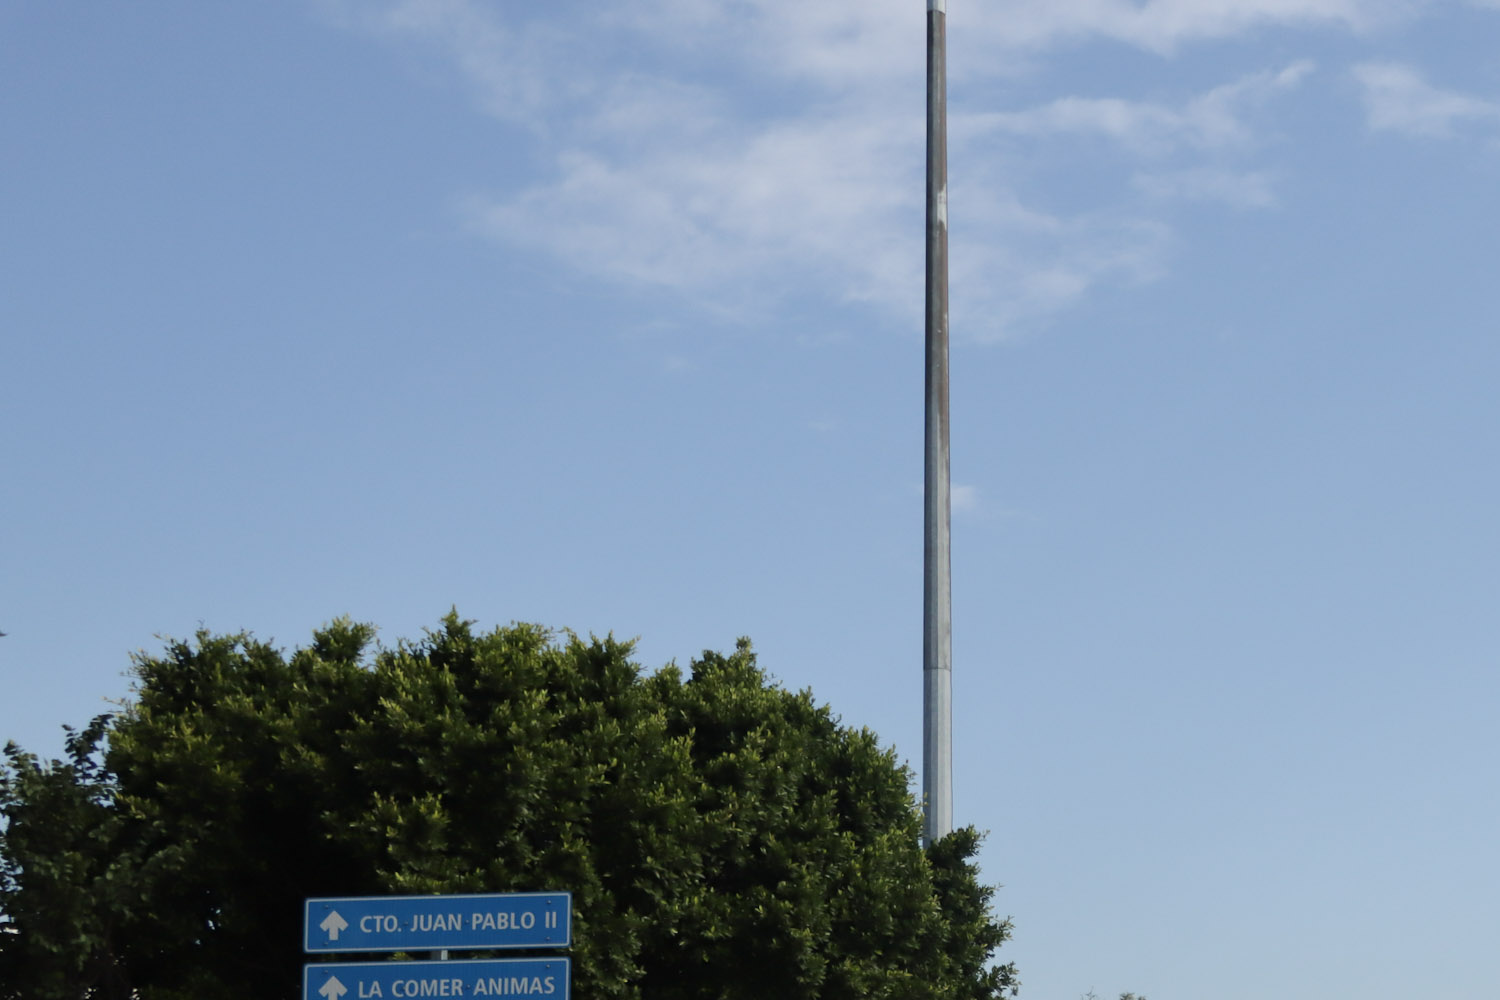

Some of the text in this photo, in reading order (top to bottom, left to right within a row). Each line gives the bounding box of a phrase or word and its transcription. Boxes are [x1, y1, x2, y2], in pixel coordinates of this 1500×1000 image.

[360, 911, 557, 933] CTO. JUAN PABLO II
[358, 976, 556, 999] LA COMER ANIMAS
